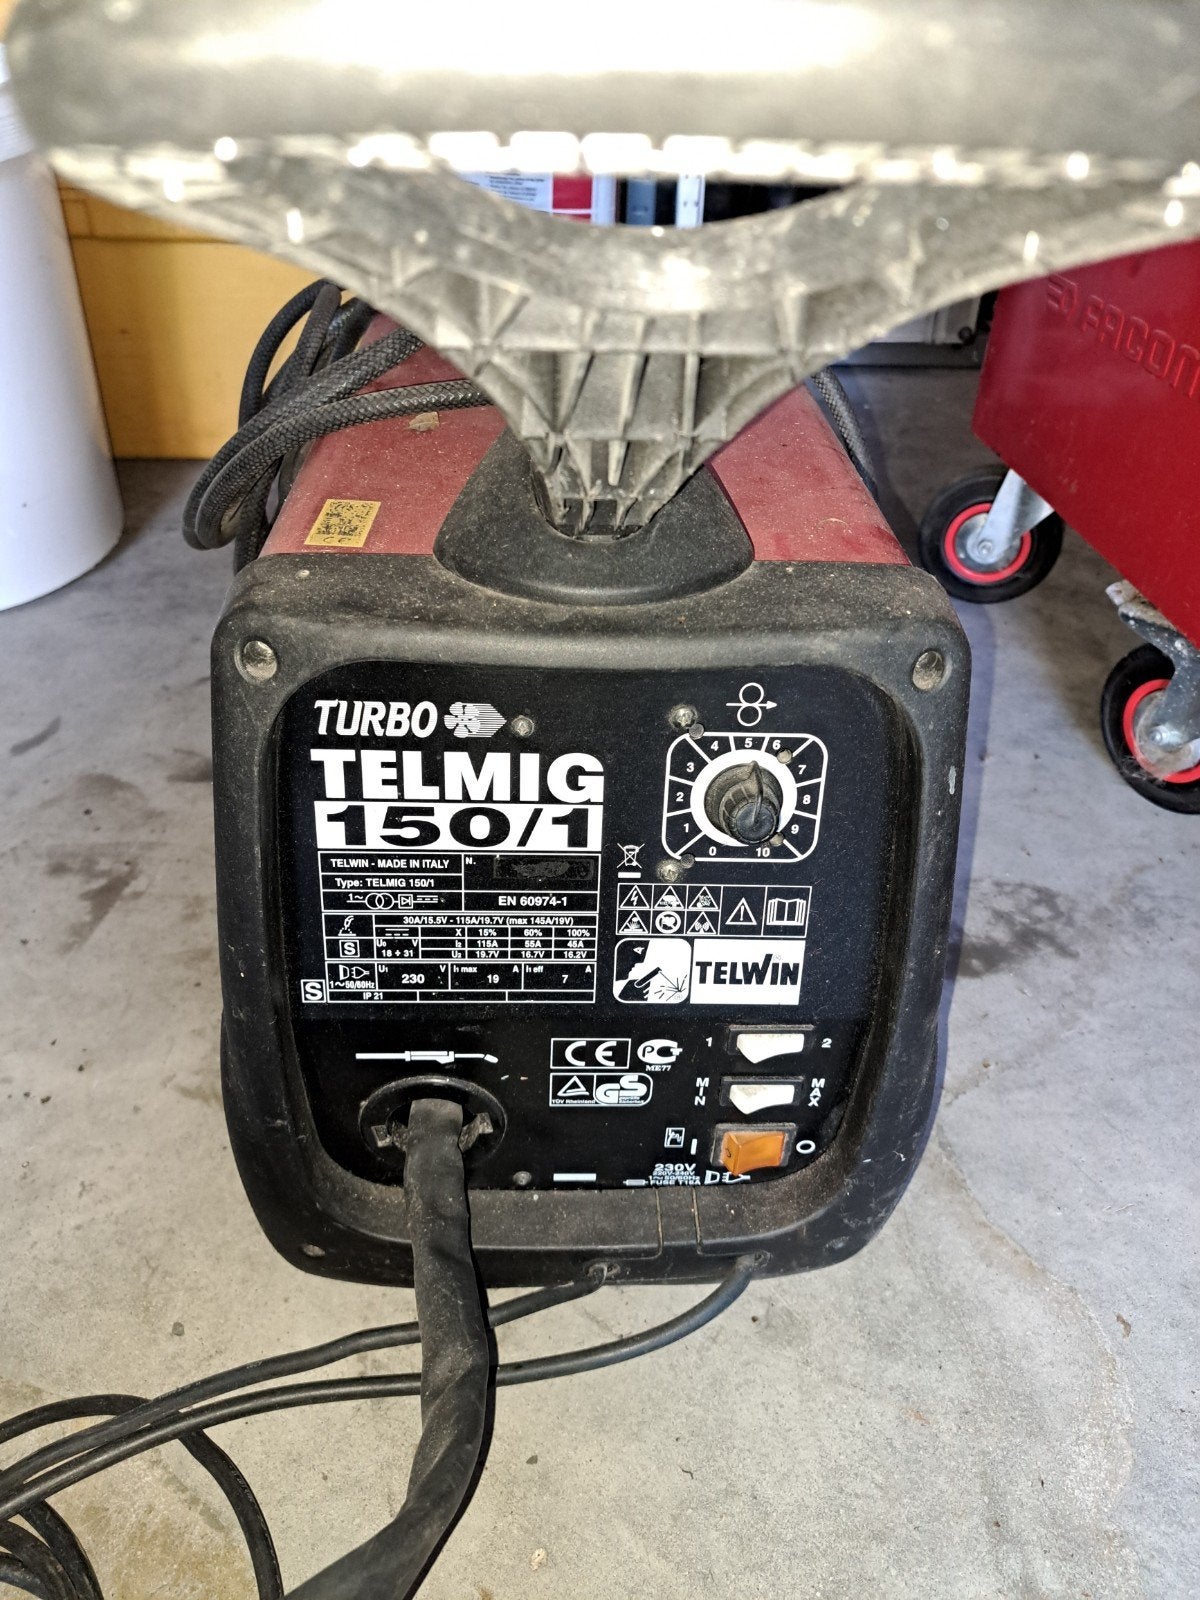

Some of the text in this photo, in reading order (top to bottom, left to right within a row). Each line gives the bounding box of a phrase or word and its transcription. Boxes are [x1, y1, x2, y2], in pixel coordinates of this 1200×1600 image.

[314, 699, 438, 738] TURBO
[711, 740, 719, 751] 4
[744, 738, 753, 748] 5
[772, 739, 781, 750] 6
[686, 762, 695, 773] 3
[798, 764, 807, 774] 7
[310, 749, 605, 803] TELMIG
[675, 792, 684, 802] 2
[802, 795, 811, 805] 8
[326, 804, 589, 848] 150/1
[683, 823, 690, 833] 1
[791, 824, 800, 834] 9
[708, 846, 717, 856] 0
[755, 846, 771, 857] 10
[331, 859, 369, 868] TELWIN
[377, 859, 407, 868] MADE
[410, 860, 420, 868] IN
[422, 859, 449, 868] ITALY
[335, 877, 435, 889] Type: TELMIG 150/1
[498, 896, 568, 906] EN 60974-1
[403, 916, 447, 924] 30A/15.5V
[456, 916, 504, 925] 115A/19.7V
[506, 916, 528, 926] (max
[530, 916, 574, 926] 145A/19V)
[567, 929, 590, 937] 100%
[411, 939, 418, 947] V
[477, 940, 498, 948] 115A
[524, 940, 542, 948] 55A
[567, 940, 584, 948] 45A
[343, 942, 356, 955] S
[512, 965, 519, 973] A
[585, 965, 592, 973] A
[695, 953, 800, 985] TELWIN
[401, 974, 425, 984] 230
[487, 974, 500, 983] 19
[561, 975, 569, 983] 7
[305, 982, 323, 1000] S
[363, 992, 383, 1000] IP 21
[706, 1037, 713, 1047] 1
[821, 1038, 832, 1048] 2
[694, 1077, 709, 1106] MIN
[808, 1078, 825, 1107] MAX
[654, 1163, 696, 1172] 230V
